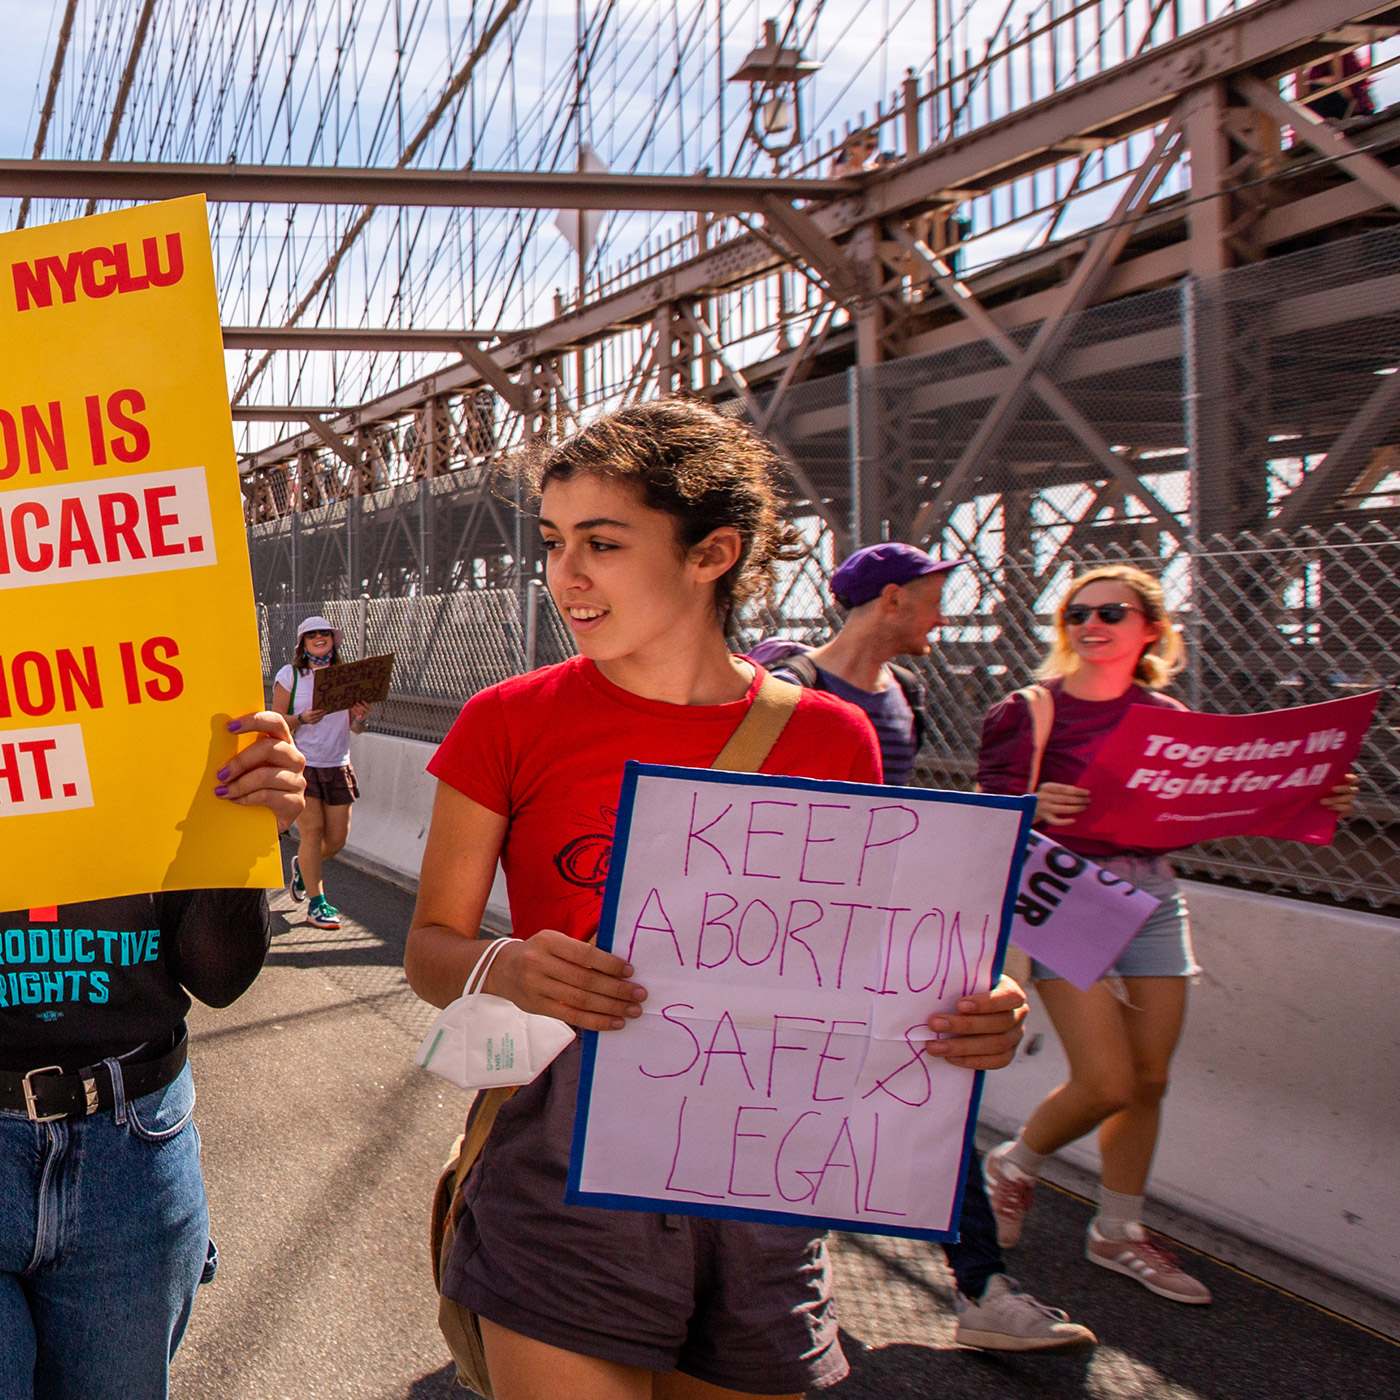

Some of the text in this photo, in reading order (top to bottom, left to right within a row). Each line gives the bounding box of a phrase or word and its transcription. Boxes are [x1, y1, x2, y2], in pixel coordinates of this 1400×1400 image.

[11, 232, 184, 312] NYCLU
[85, 388, 151, 466] IS
[120, 636, 185, 705] IS
[1126, 762, 1332, 800] Fight for All
[1143, 728, 1348, 768] Together We
[684, 792, 920, 886] KEEP
[1013, 846, 1087, 926] OUR
[626, 887, 990, 1000] ABORTION
[638, 1003, 868, 1102] SAFE
[664, 1096, 908, 1217] LEGAL
